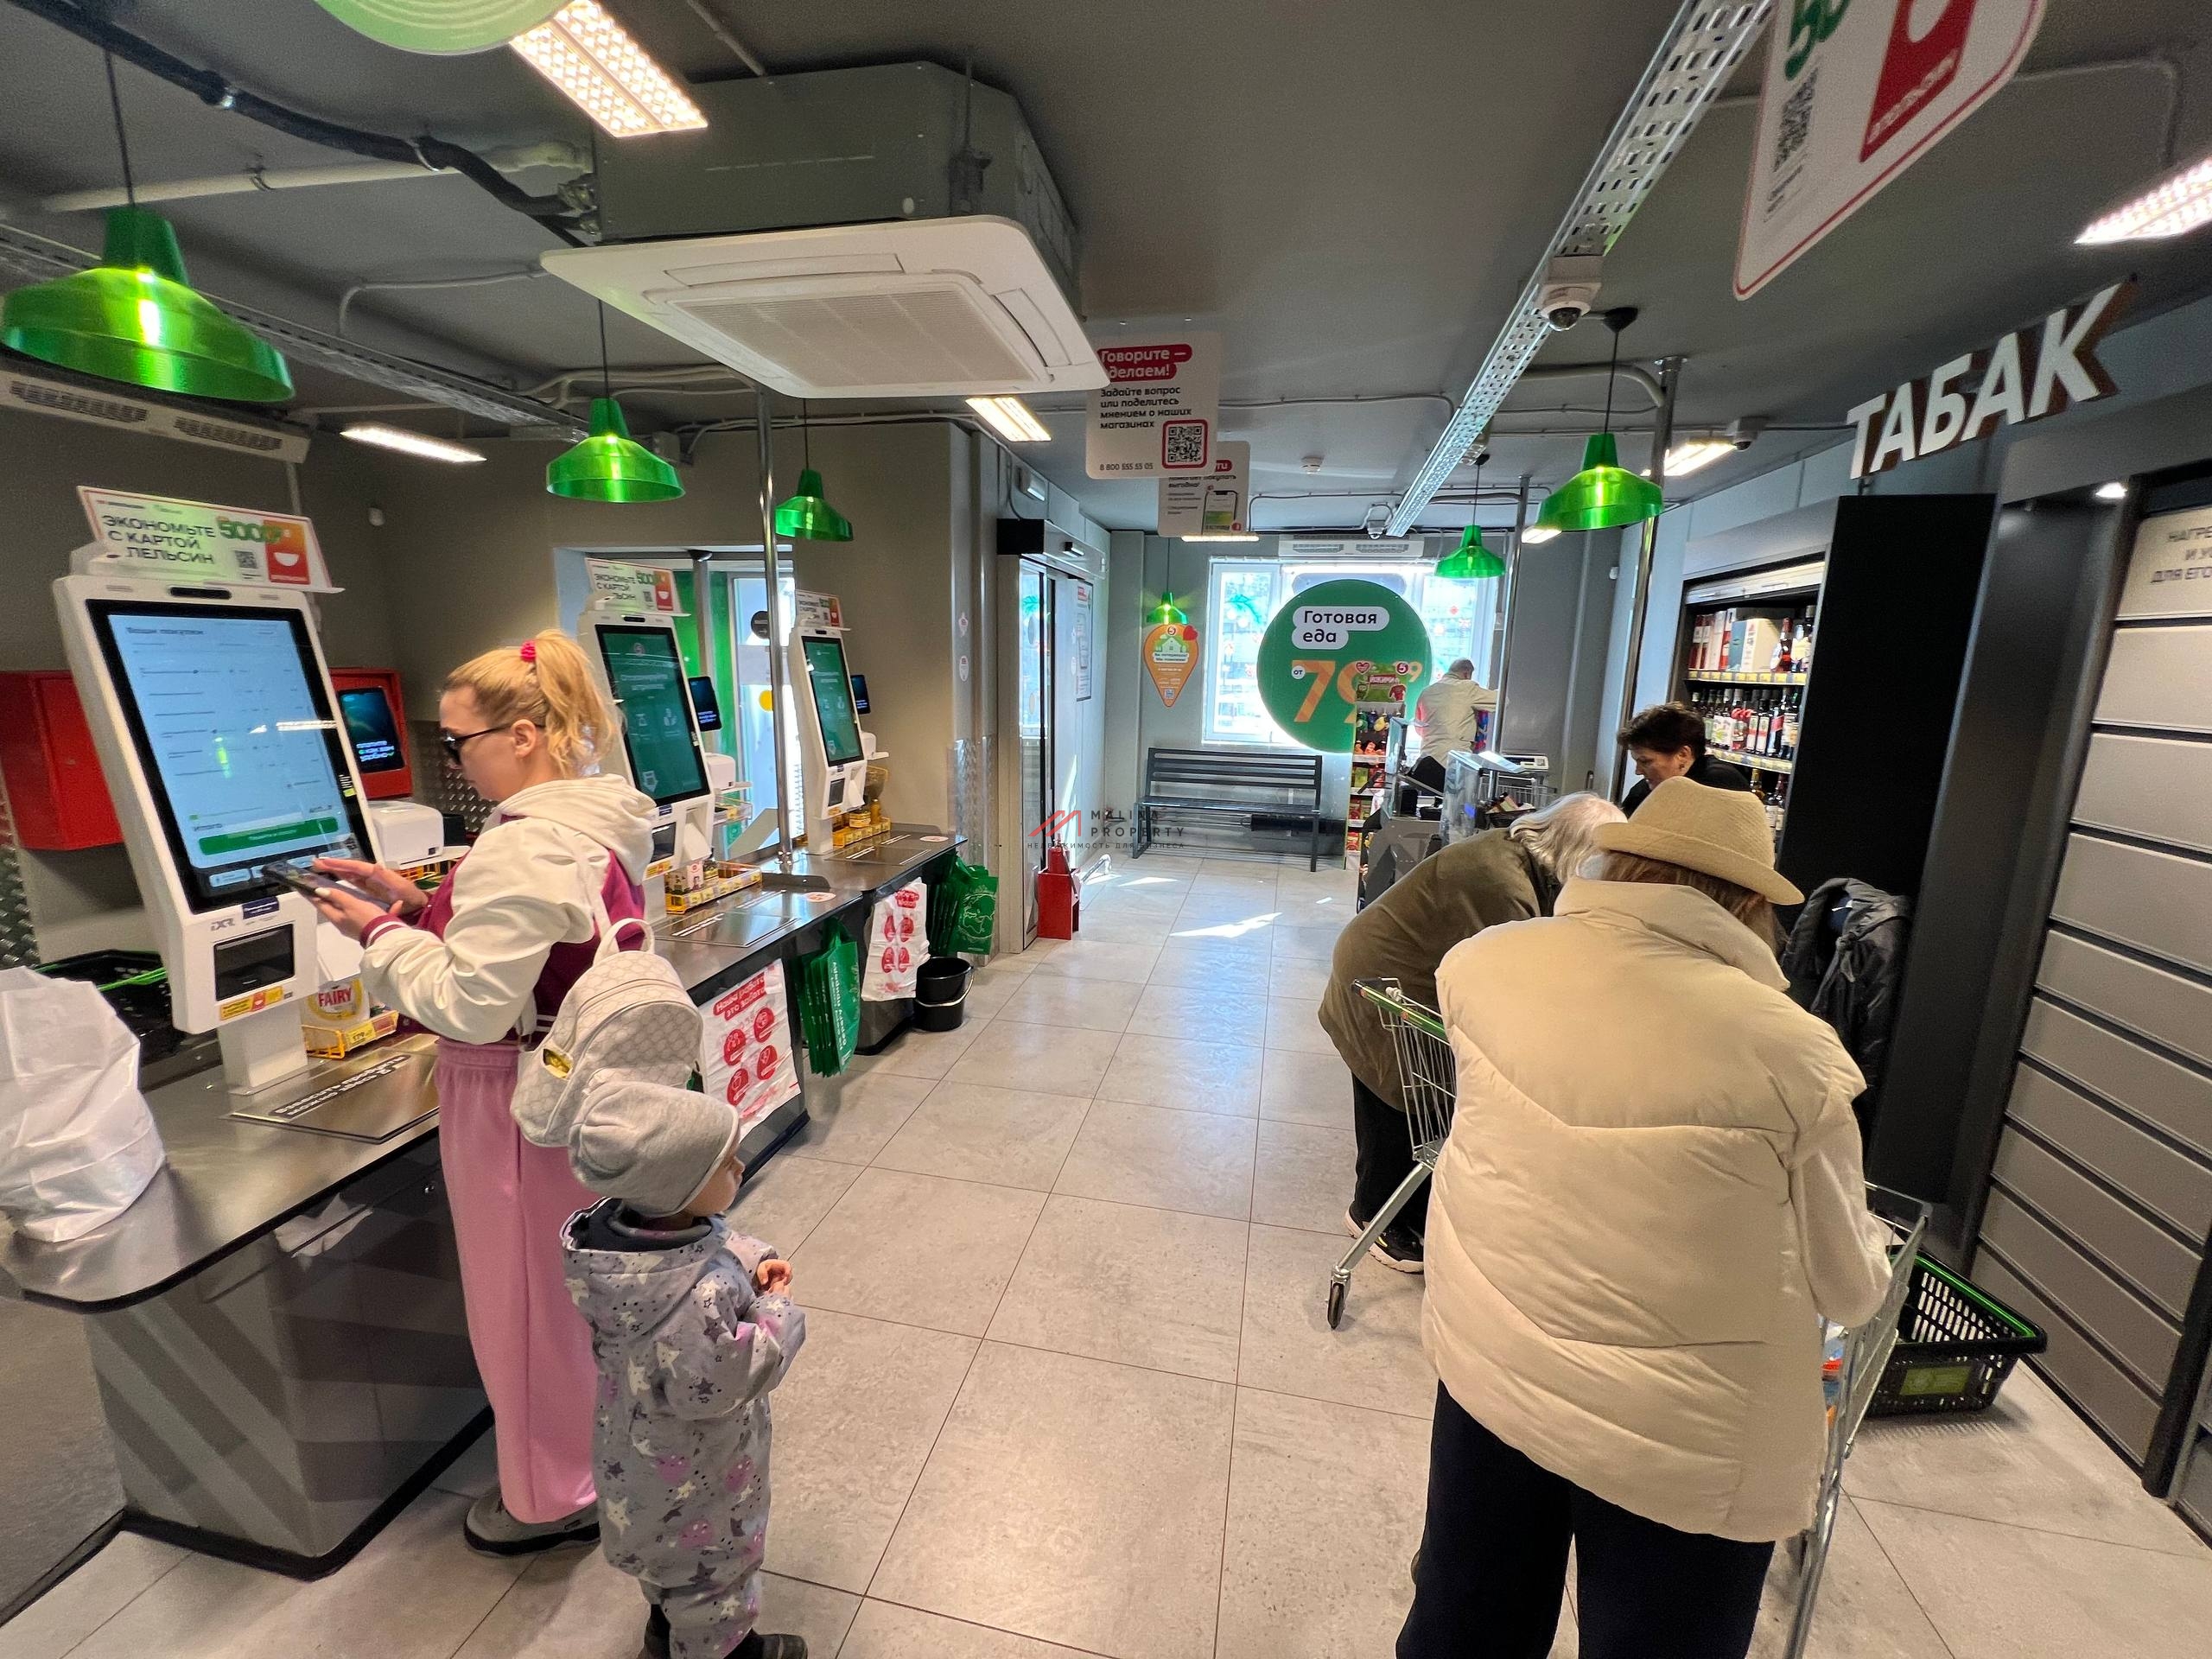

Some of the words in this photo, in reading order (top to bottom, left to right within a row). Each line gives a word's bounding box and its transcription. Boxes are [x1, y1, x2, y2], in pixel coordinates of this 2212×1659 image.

[1101, 349, 1170, 364] Говорите
[1109, 364, 1170, 378] делаем!
[1847, 283, 2123, 480] ТАБАК
[1100, 388, 1142, 397] Задайте
[1144, 387, 1181, 397] вопрос
[1121, 398, 1179, 407] поделитесь
[1100, 410, 1147, 419] мнением
[1100, 421, 1155, 429] магазинах
[102, 515, 216, 537] ЭКОНОМЬТЕ
[108, 530, 123, 541] С
[125, 531, 200, 549] КАРТОЙ
[124, 546, 215, 564] ПЕЛЬСИН
[1303, 610, 1378, 625] Готовая
[1303, 628, 1338, 643] еда
[318, 987, 353, 1007] FAIRY
